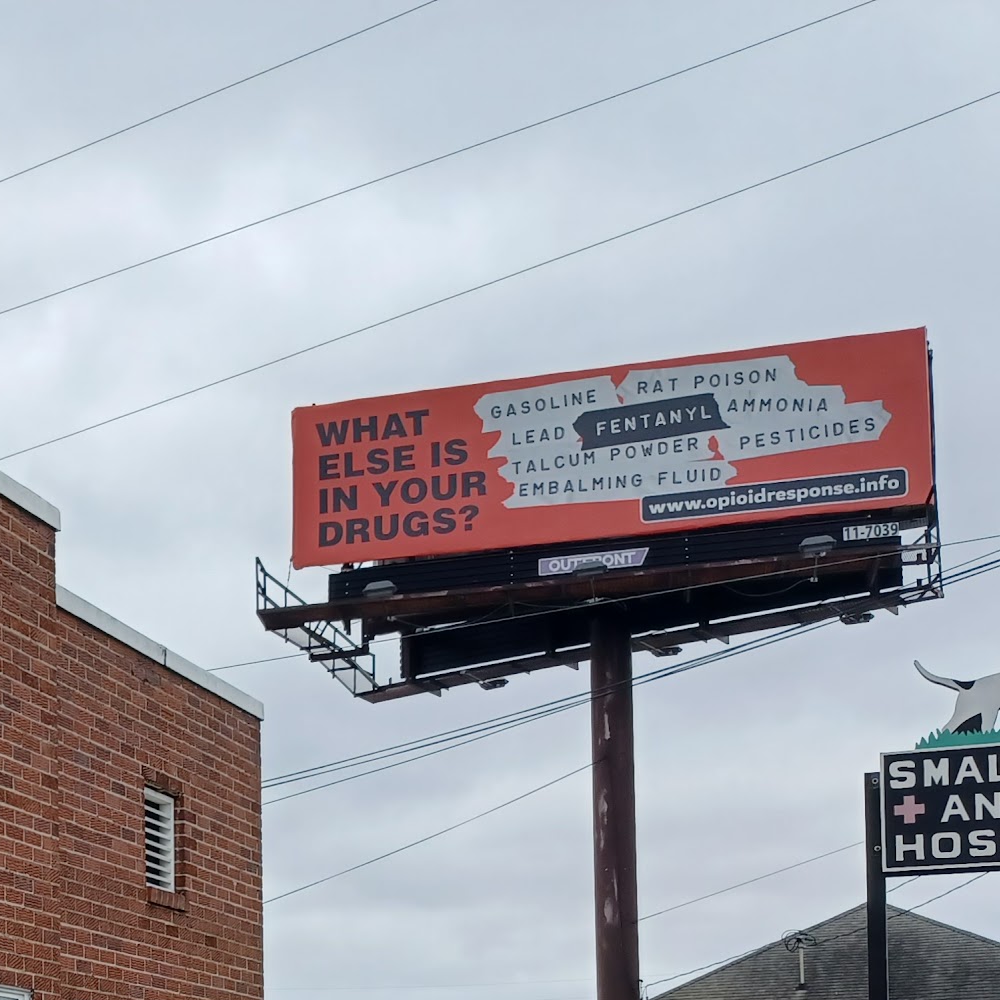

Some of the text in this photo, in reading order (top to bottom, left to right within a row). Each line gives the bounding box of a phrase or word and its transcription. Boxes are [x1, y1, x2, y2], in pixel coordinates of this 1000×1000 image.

[637, 367, 777, 395] RAT POISON
[490, 389, 597, 419] GASOLINE
[727, 397, 828, 413] AMMONIA
[316, 409, 430, 447] WHAT
[512, 426, 566, 446] LEAD
[596, 404, 712, 437] FENTANYL
[739, 417, 876, 450] PESTICIDES
[318, 439, 468, 481] ELSE IS
[512, 436, 699, 475] TALCUM POWDER
[319, 470, 487, 514] IN YOUR
[519, 467, 722, 497] EMBALMING FLUID
[649, 474, 900, 515] www.opioidresponse.info
[318, 505, 480, 548] DRUGS?
[844, 523, 898, 539] 11-7039
[548, 551, 636, 572] OUTONT
[941, 791, 1000, 822] AN
[895, 830, 997, 861] HOS
